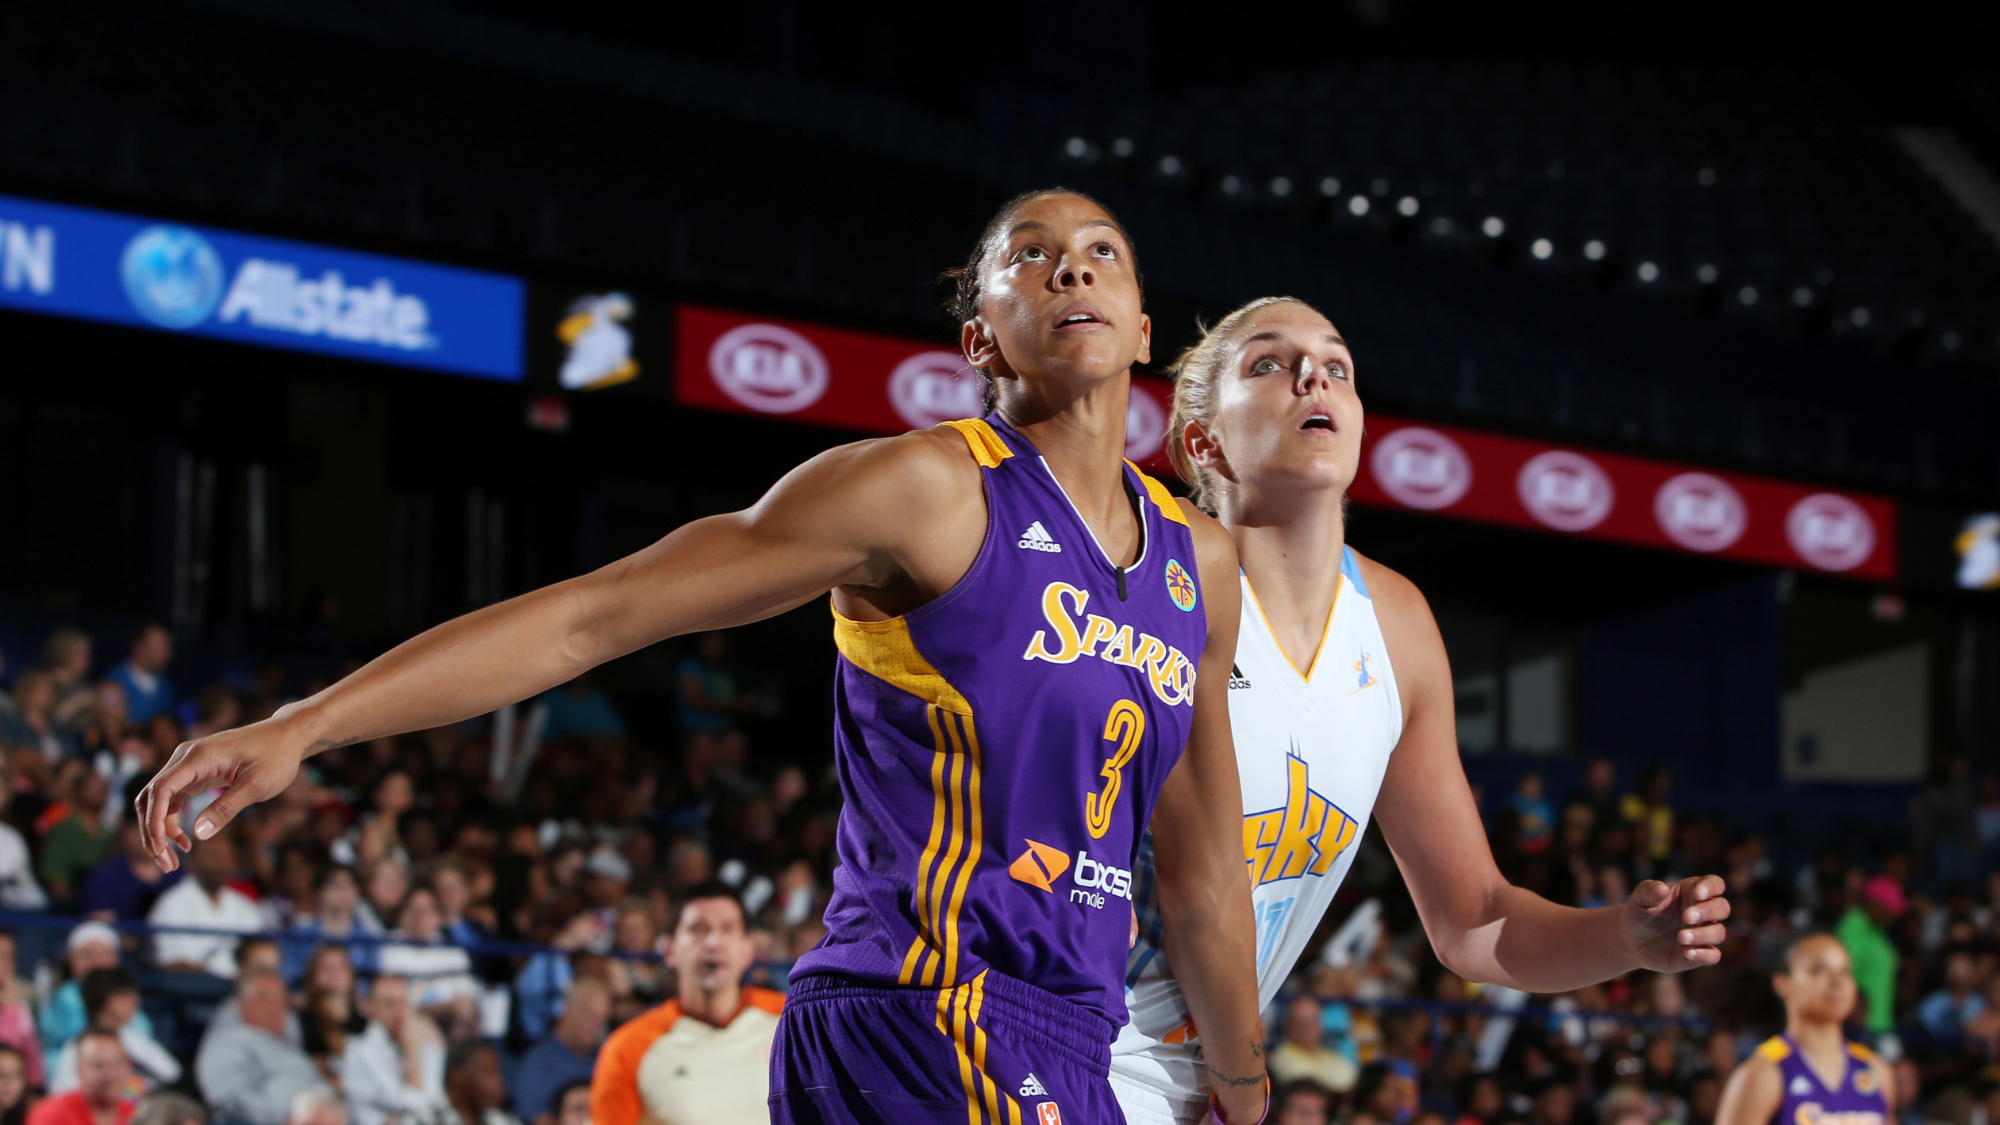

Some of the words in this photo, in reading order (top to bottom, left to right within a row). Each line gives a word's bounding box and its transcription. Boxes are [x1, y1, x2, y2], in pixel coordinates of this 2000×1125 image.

[1018, 538, 1062, 553] adidas
[1229, 679, 1251, 690] das
[1085, 698, 1146, 840] 3
